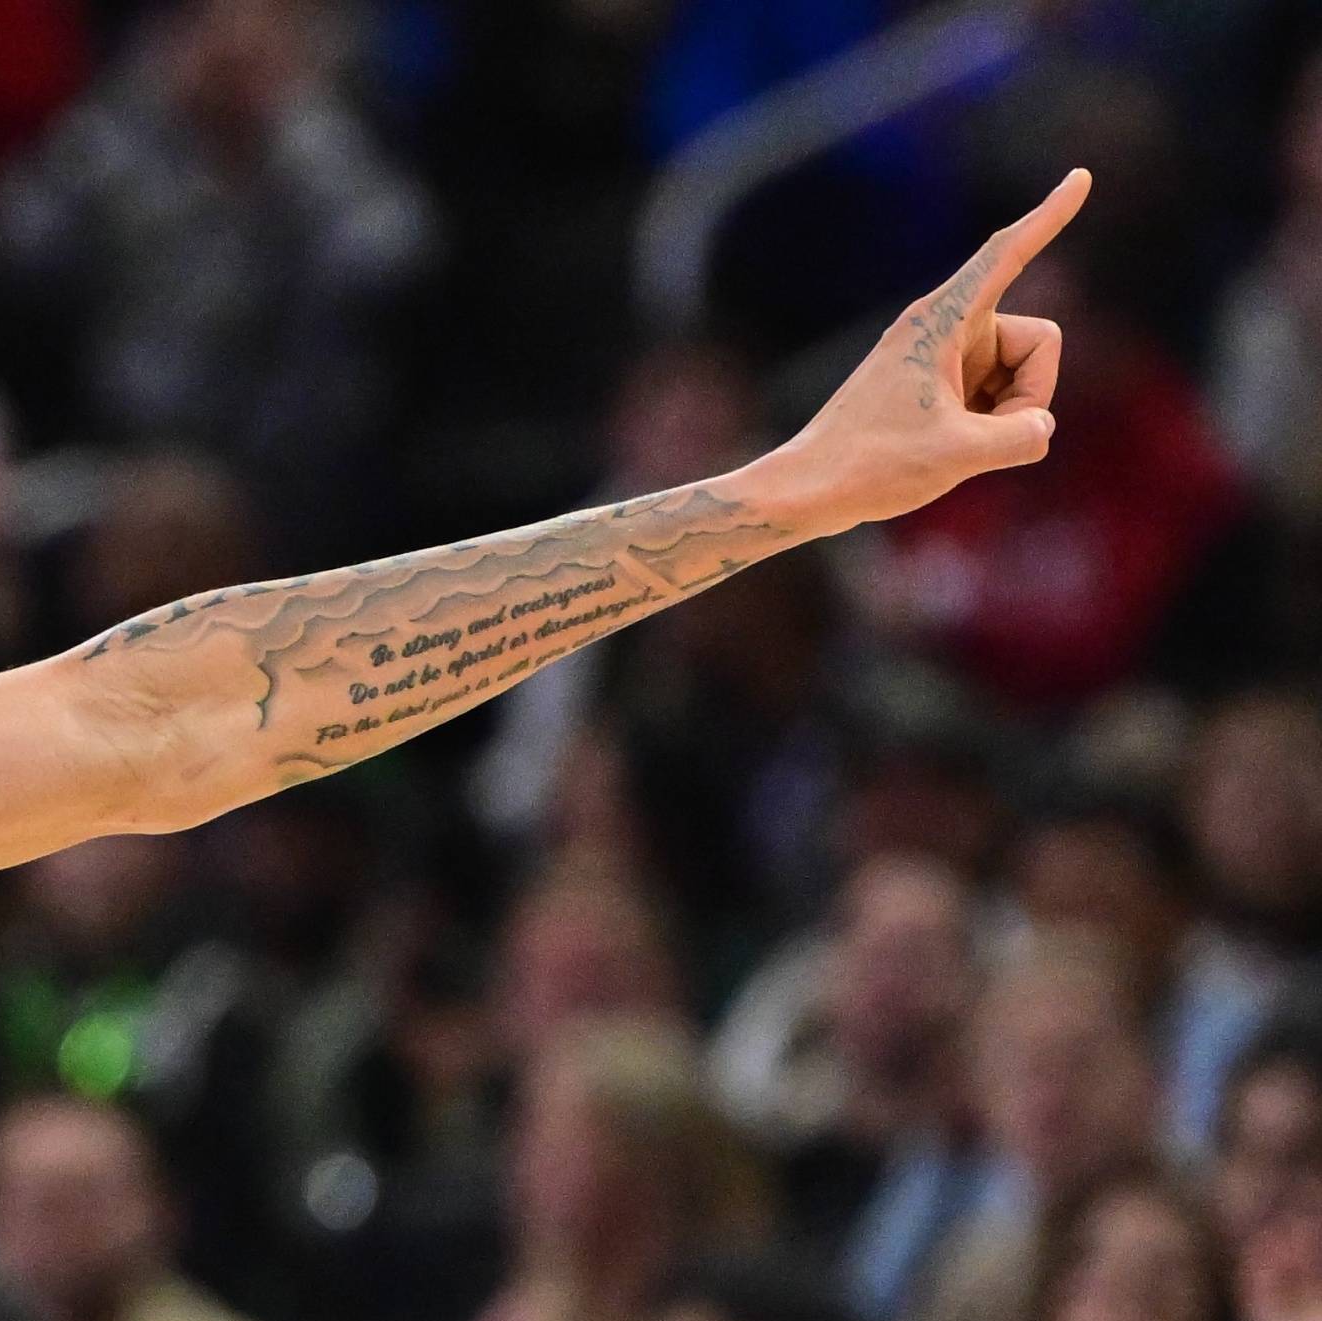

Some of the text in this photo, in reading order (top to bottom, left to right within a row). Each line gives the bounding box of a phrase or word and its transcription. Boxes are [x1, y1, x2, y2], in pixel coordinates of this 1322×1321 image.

[370, 644, 395, 667] Be
[402, 628, 462, 658] strong
[468, 605, 507, 635] and
[349, 683, 379, 705] Do
[384, 670, 417, 696] not
